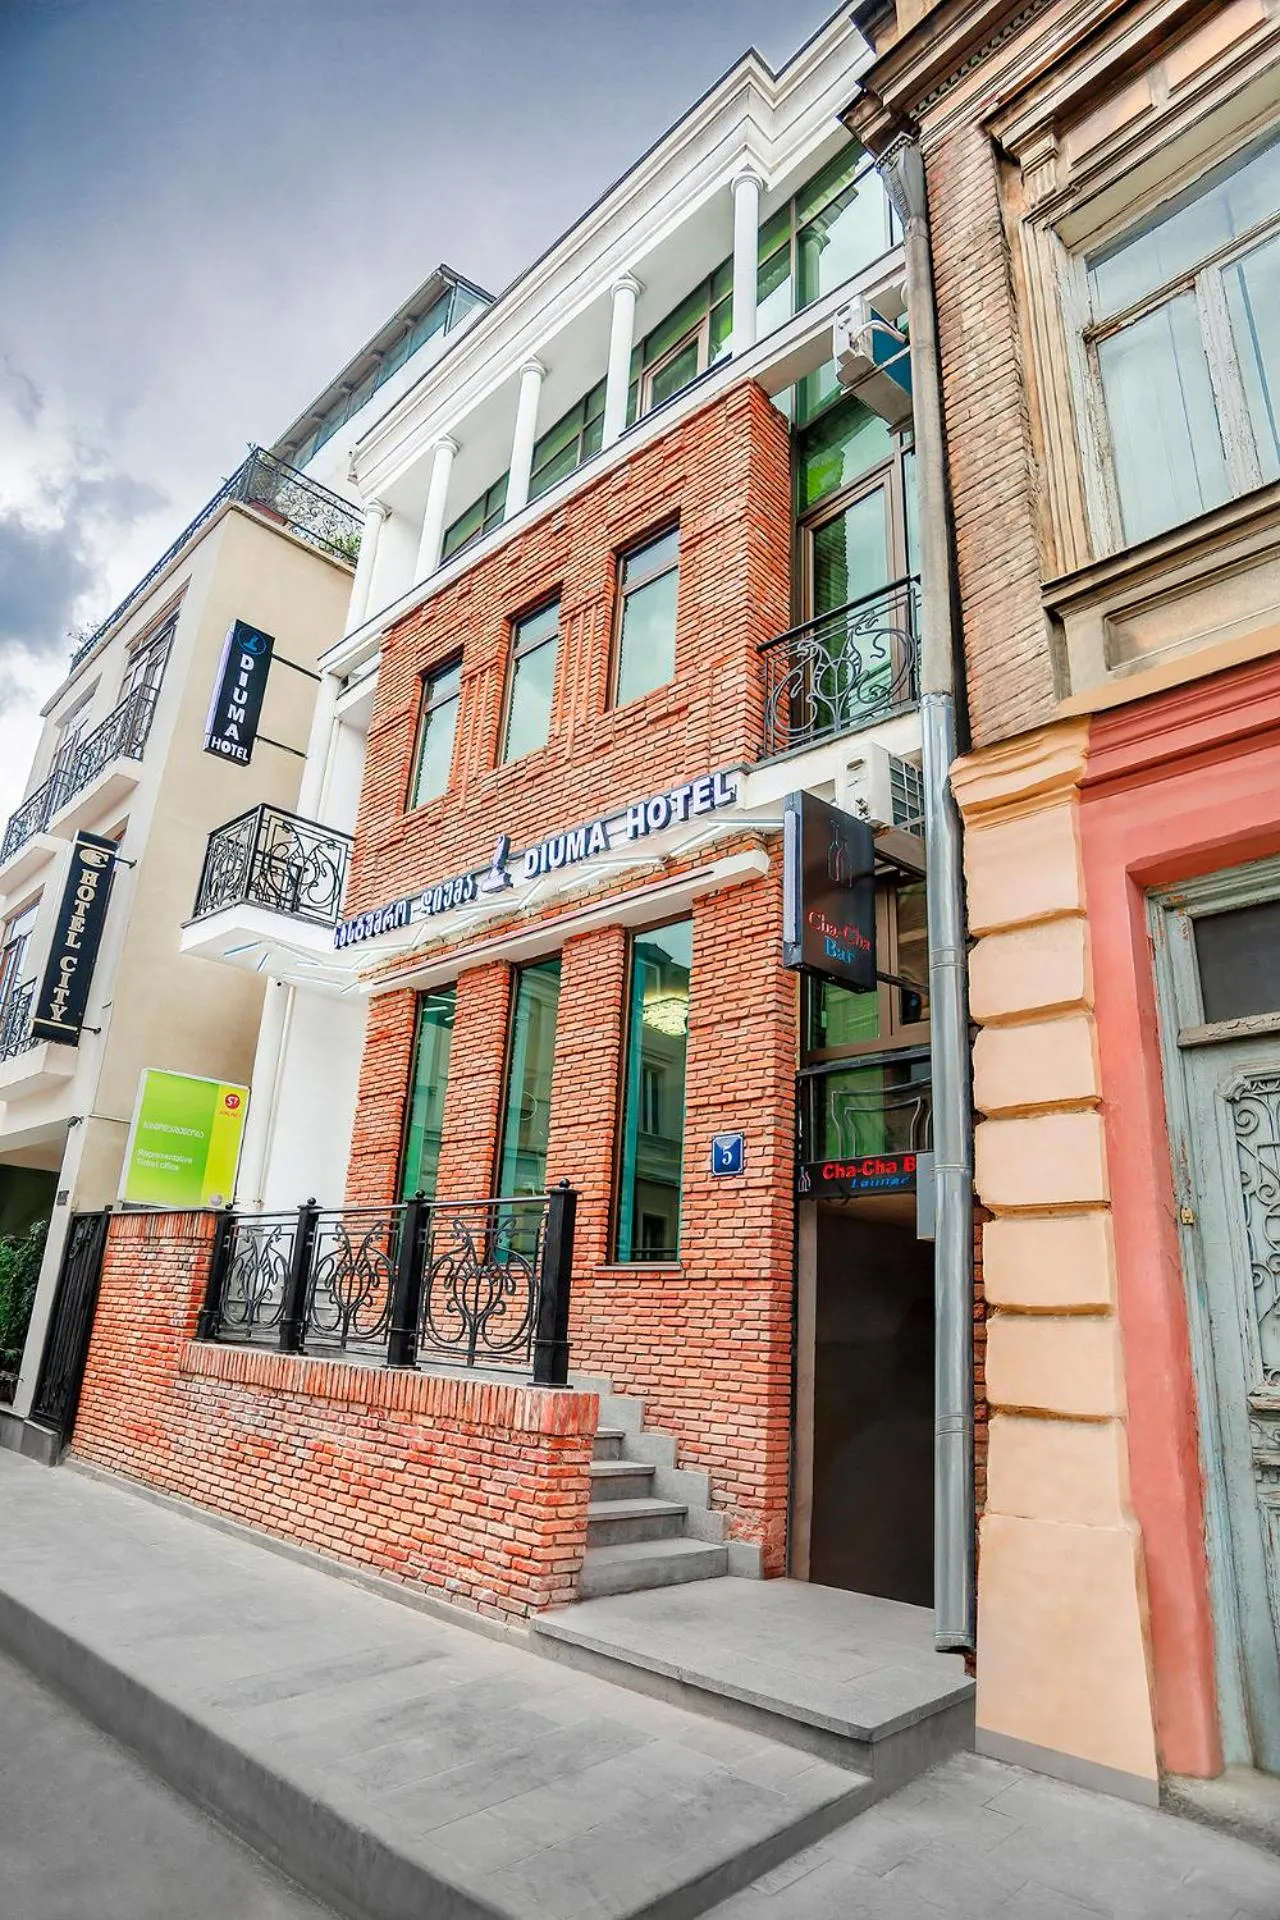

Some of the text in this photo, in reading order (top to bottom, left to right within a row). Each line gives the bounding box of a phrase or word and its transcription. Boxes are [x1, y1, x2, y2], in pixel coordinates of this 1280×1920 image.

[224, 653, 255, 741] DIUMA
[210, 737, 249, 761] HOTEL
[524, 772, 734, 877] DIUMA HOTEL
[50, 868, 99, 1022] HOTEL CITY
[808, 911, 871, 952] Cha-Cha
[824, 935, 855, 964] Bar
[721, 1145, 733, 1166] 5
[822, 1158, 897, 1180] Cha-Cha
